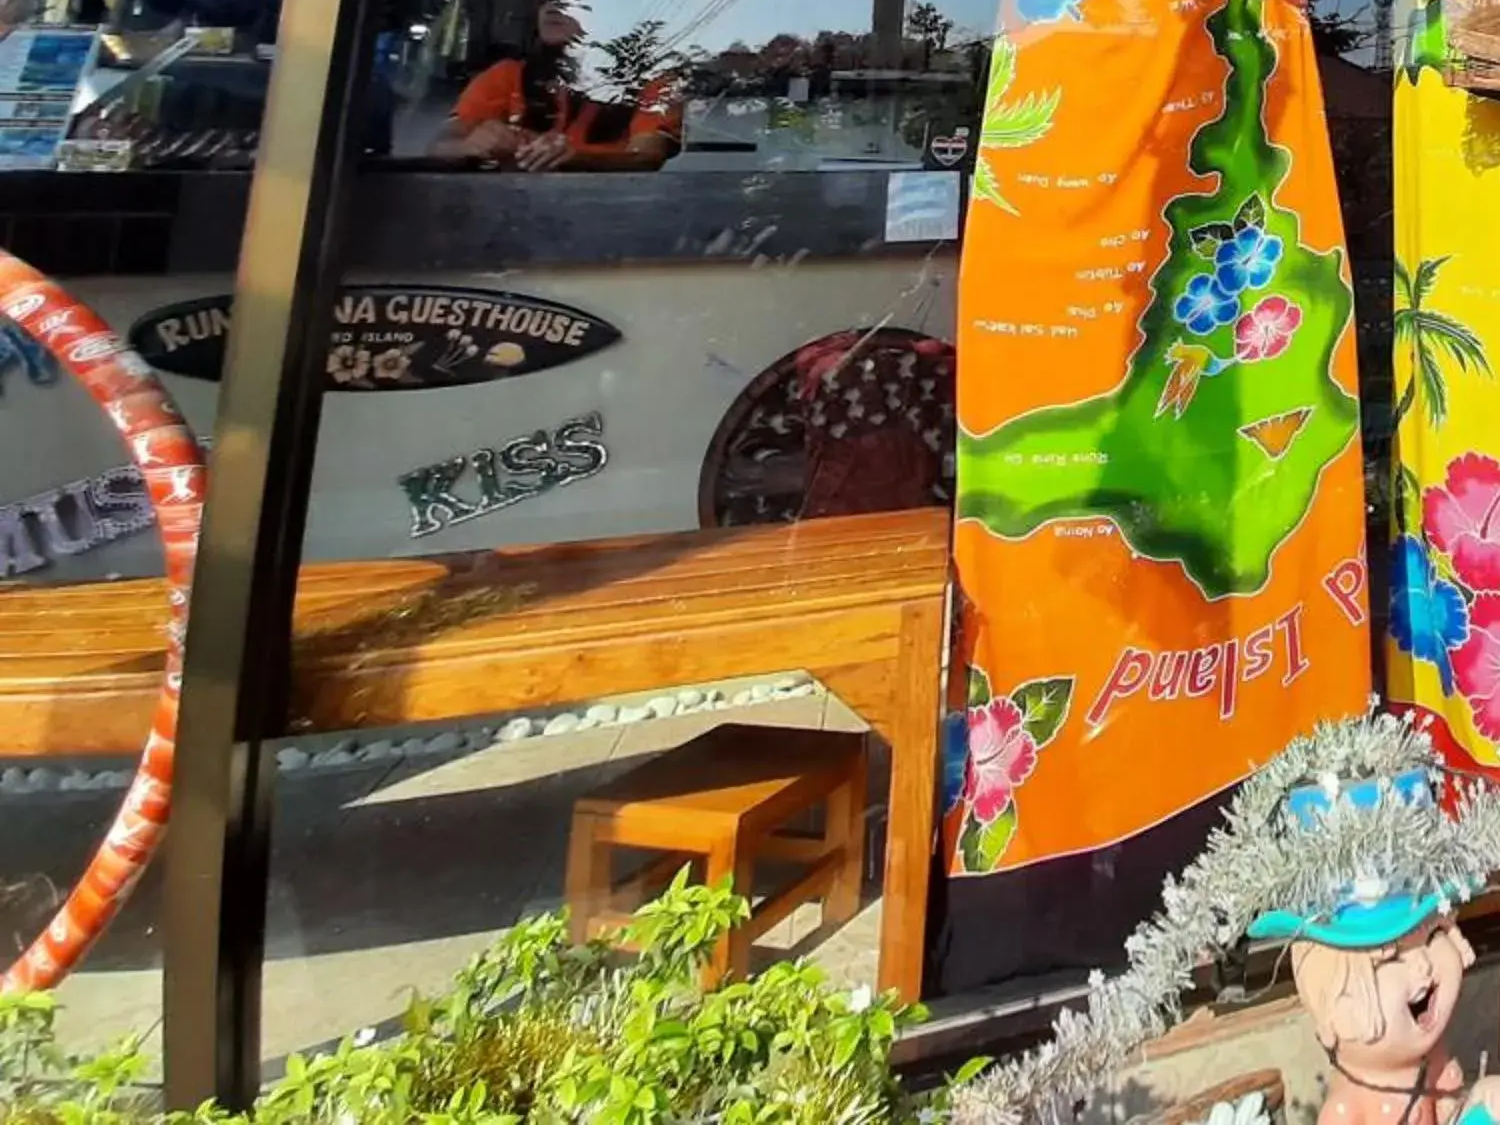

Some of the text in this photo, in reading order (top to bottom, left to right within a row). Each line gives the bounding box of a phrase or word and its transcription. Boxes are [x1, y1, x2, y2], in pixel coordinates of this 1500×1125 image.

[156, 308, 234, 353] RUN
[386, 295, 591, 347] GUESTHOUSE
[398, 412, 608, 539] KISS
[1085, 602, 1310, 726] Island
